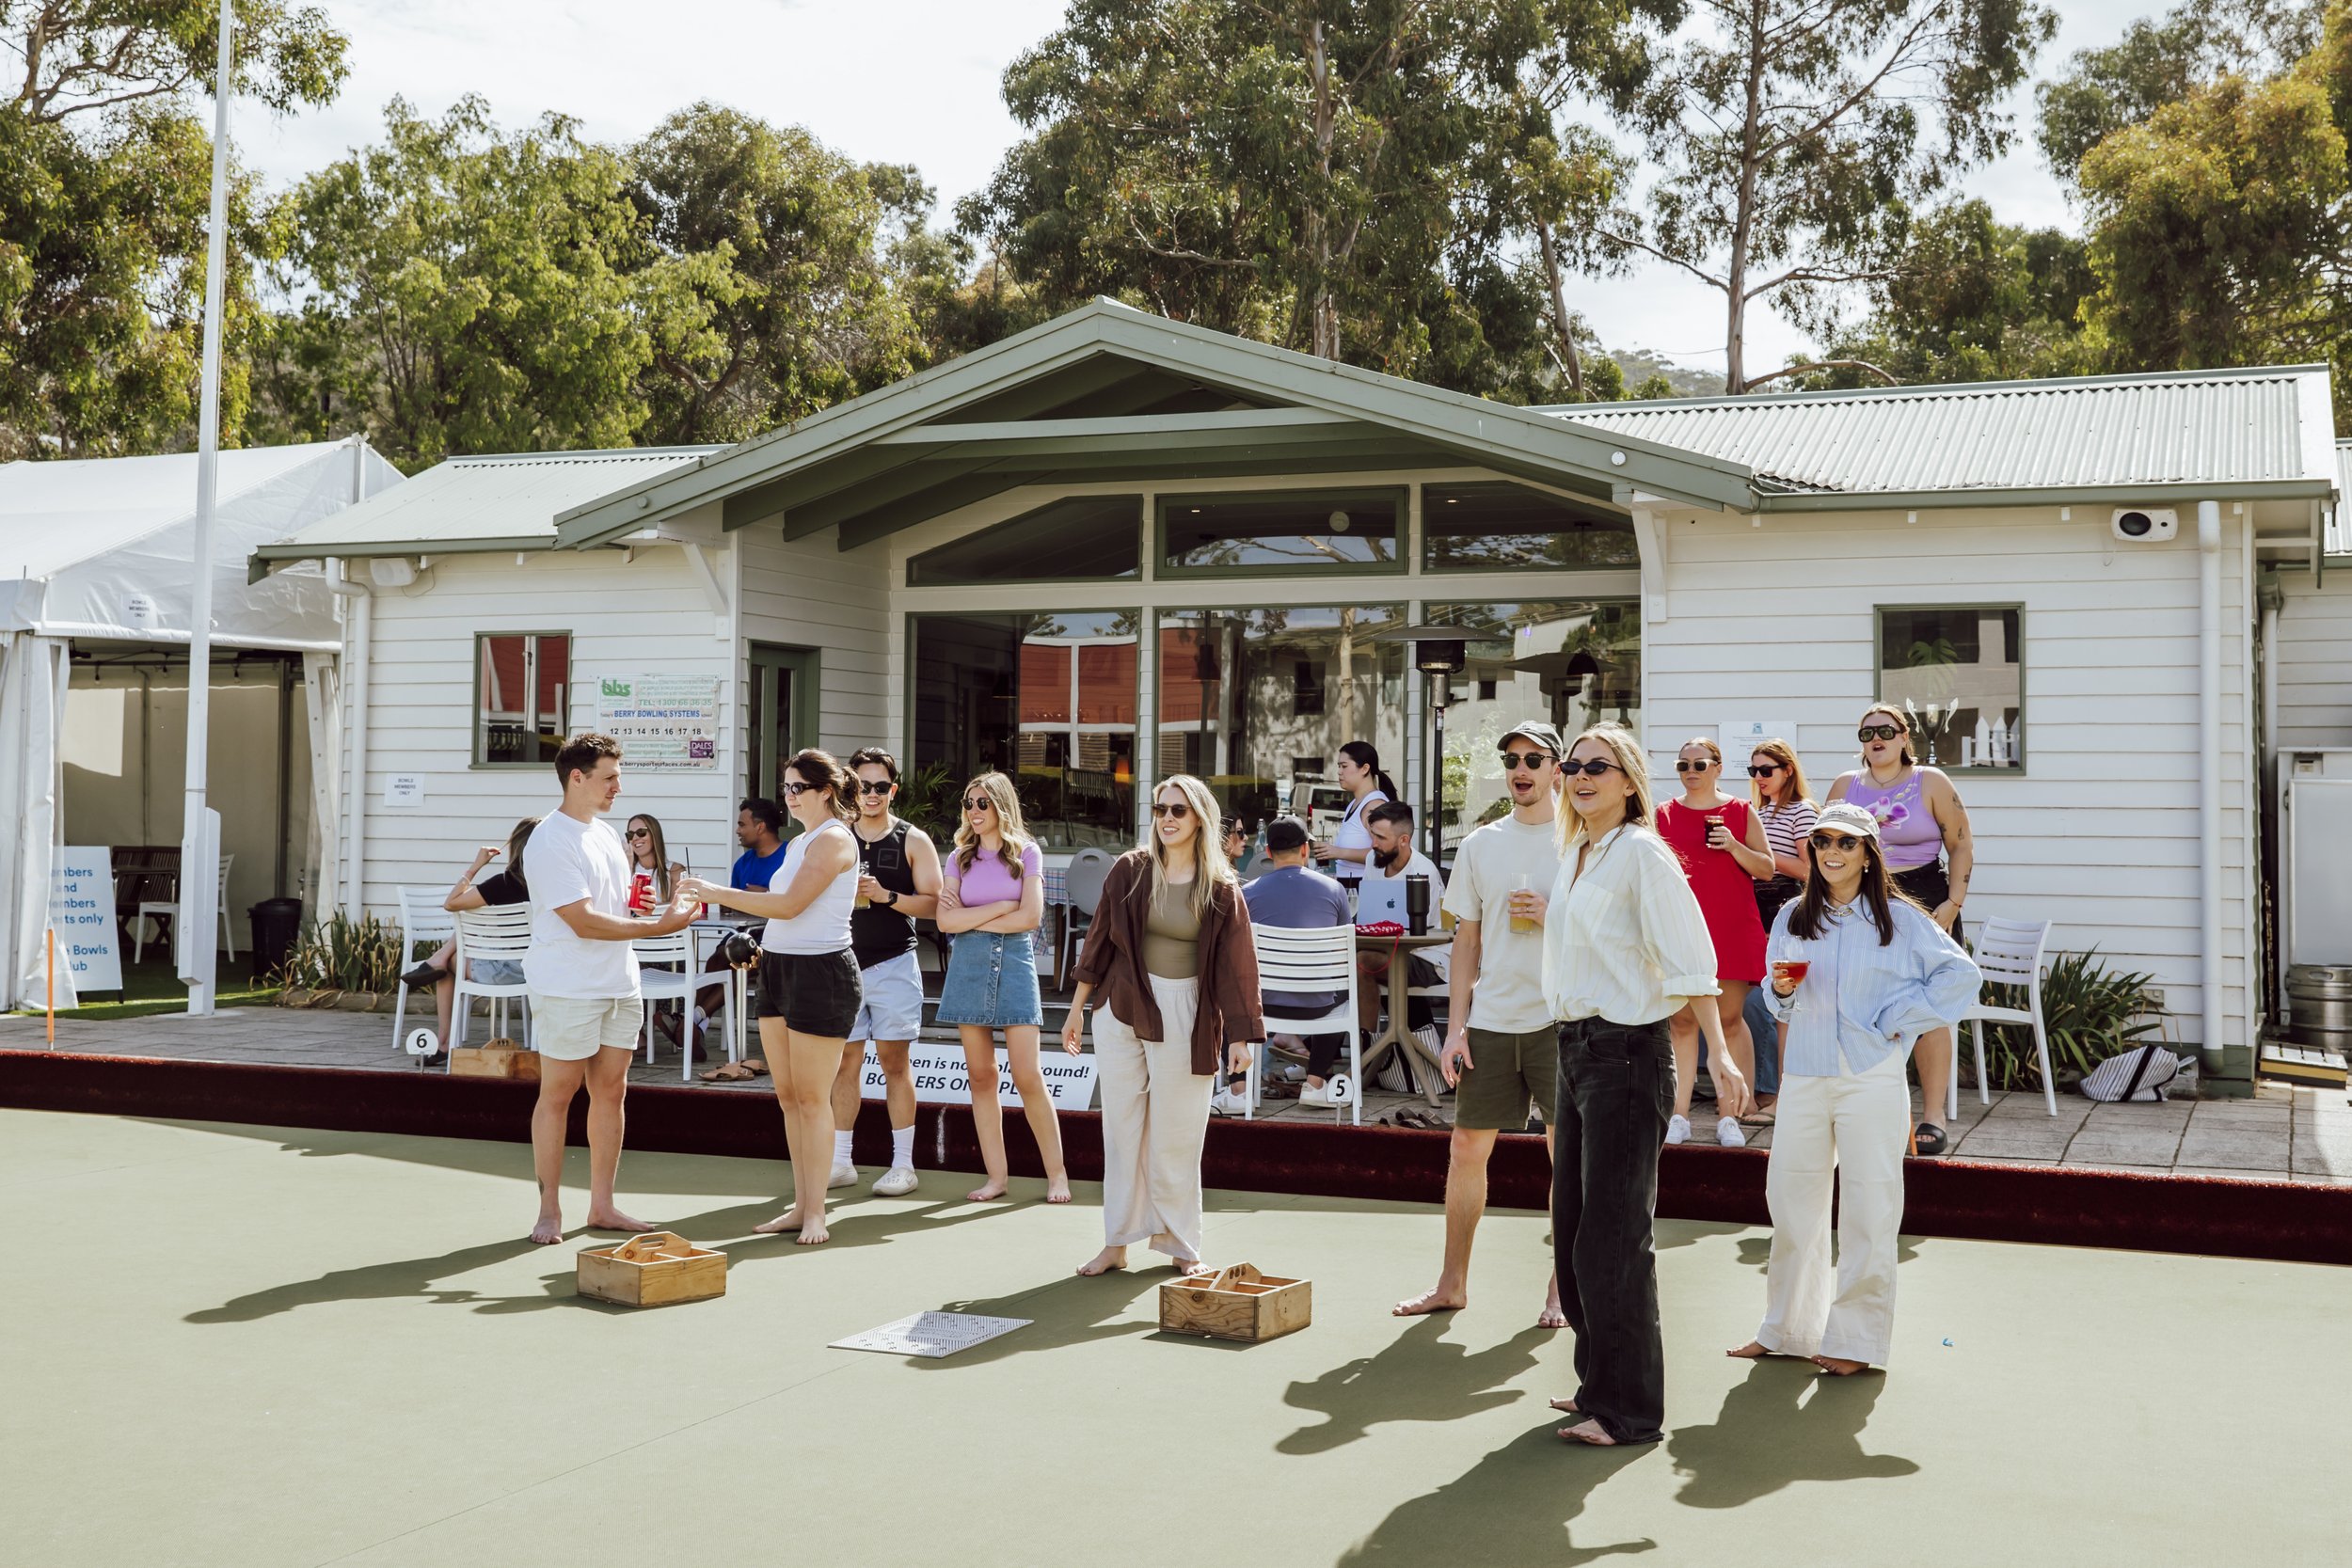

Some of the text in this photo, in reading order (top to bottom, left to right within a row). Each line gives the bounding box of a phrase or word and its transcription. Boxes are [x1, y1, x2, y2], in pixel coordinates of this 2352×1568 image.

[78, 913, 103, 927] only
[73, 944, 108, 956] Bowls
[416, 1033, 428, 1049] 6
[934, 1056, 946, 1069] is
[1335, 1079, 1345, 1098] 5
